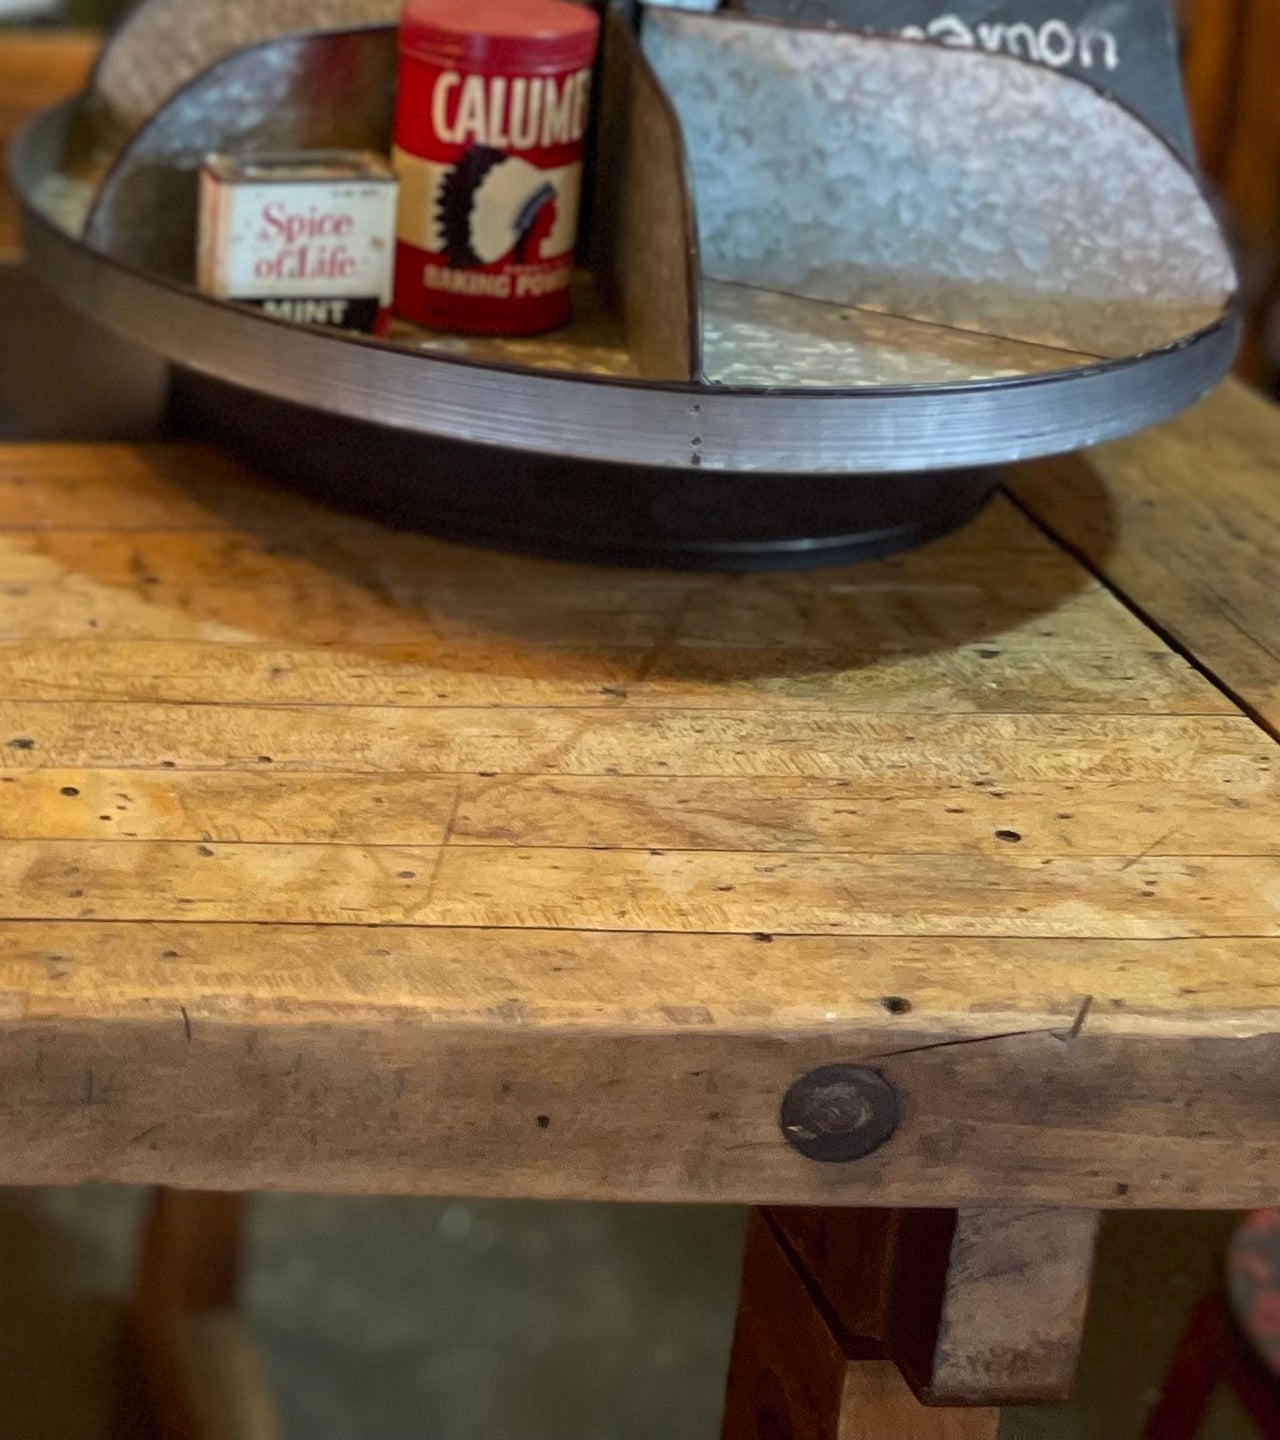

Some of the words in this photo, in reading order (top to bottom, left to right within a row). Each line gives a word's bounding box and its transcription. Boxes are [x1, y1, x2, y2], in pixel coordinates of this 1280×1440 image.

[258, 201, 354, 244] Spice
[253, 248, 294, 279] of
[290, 244, 357, 280] Life
